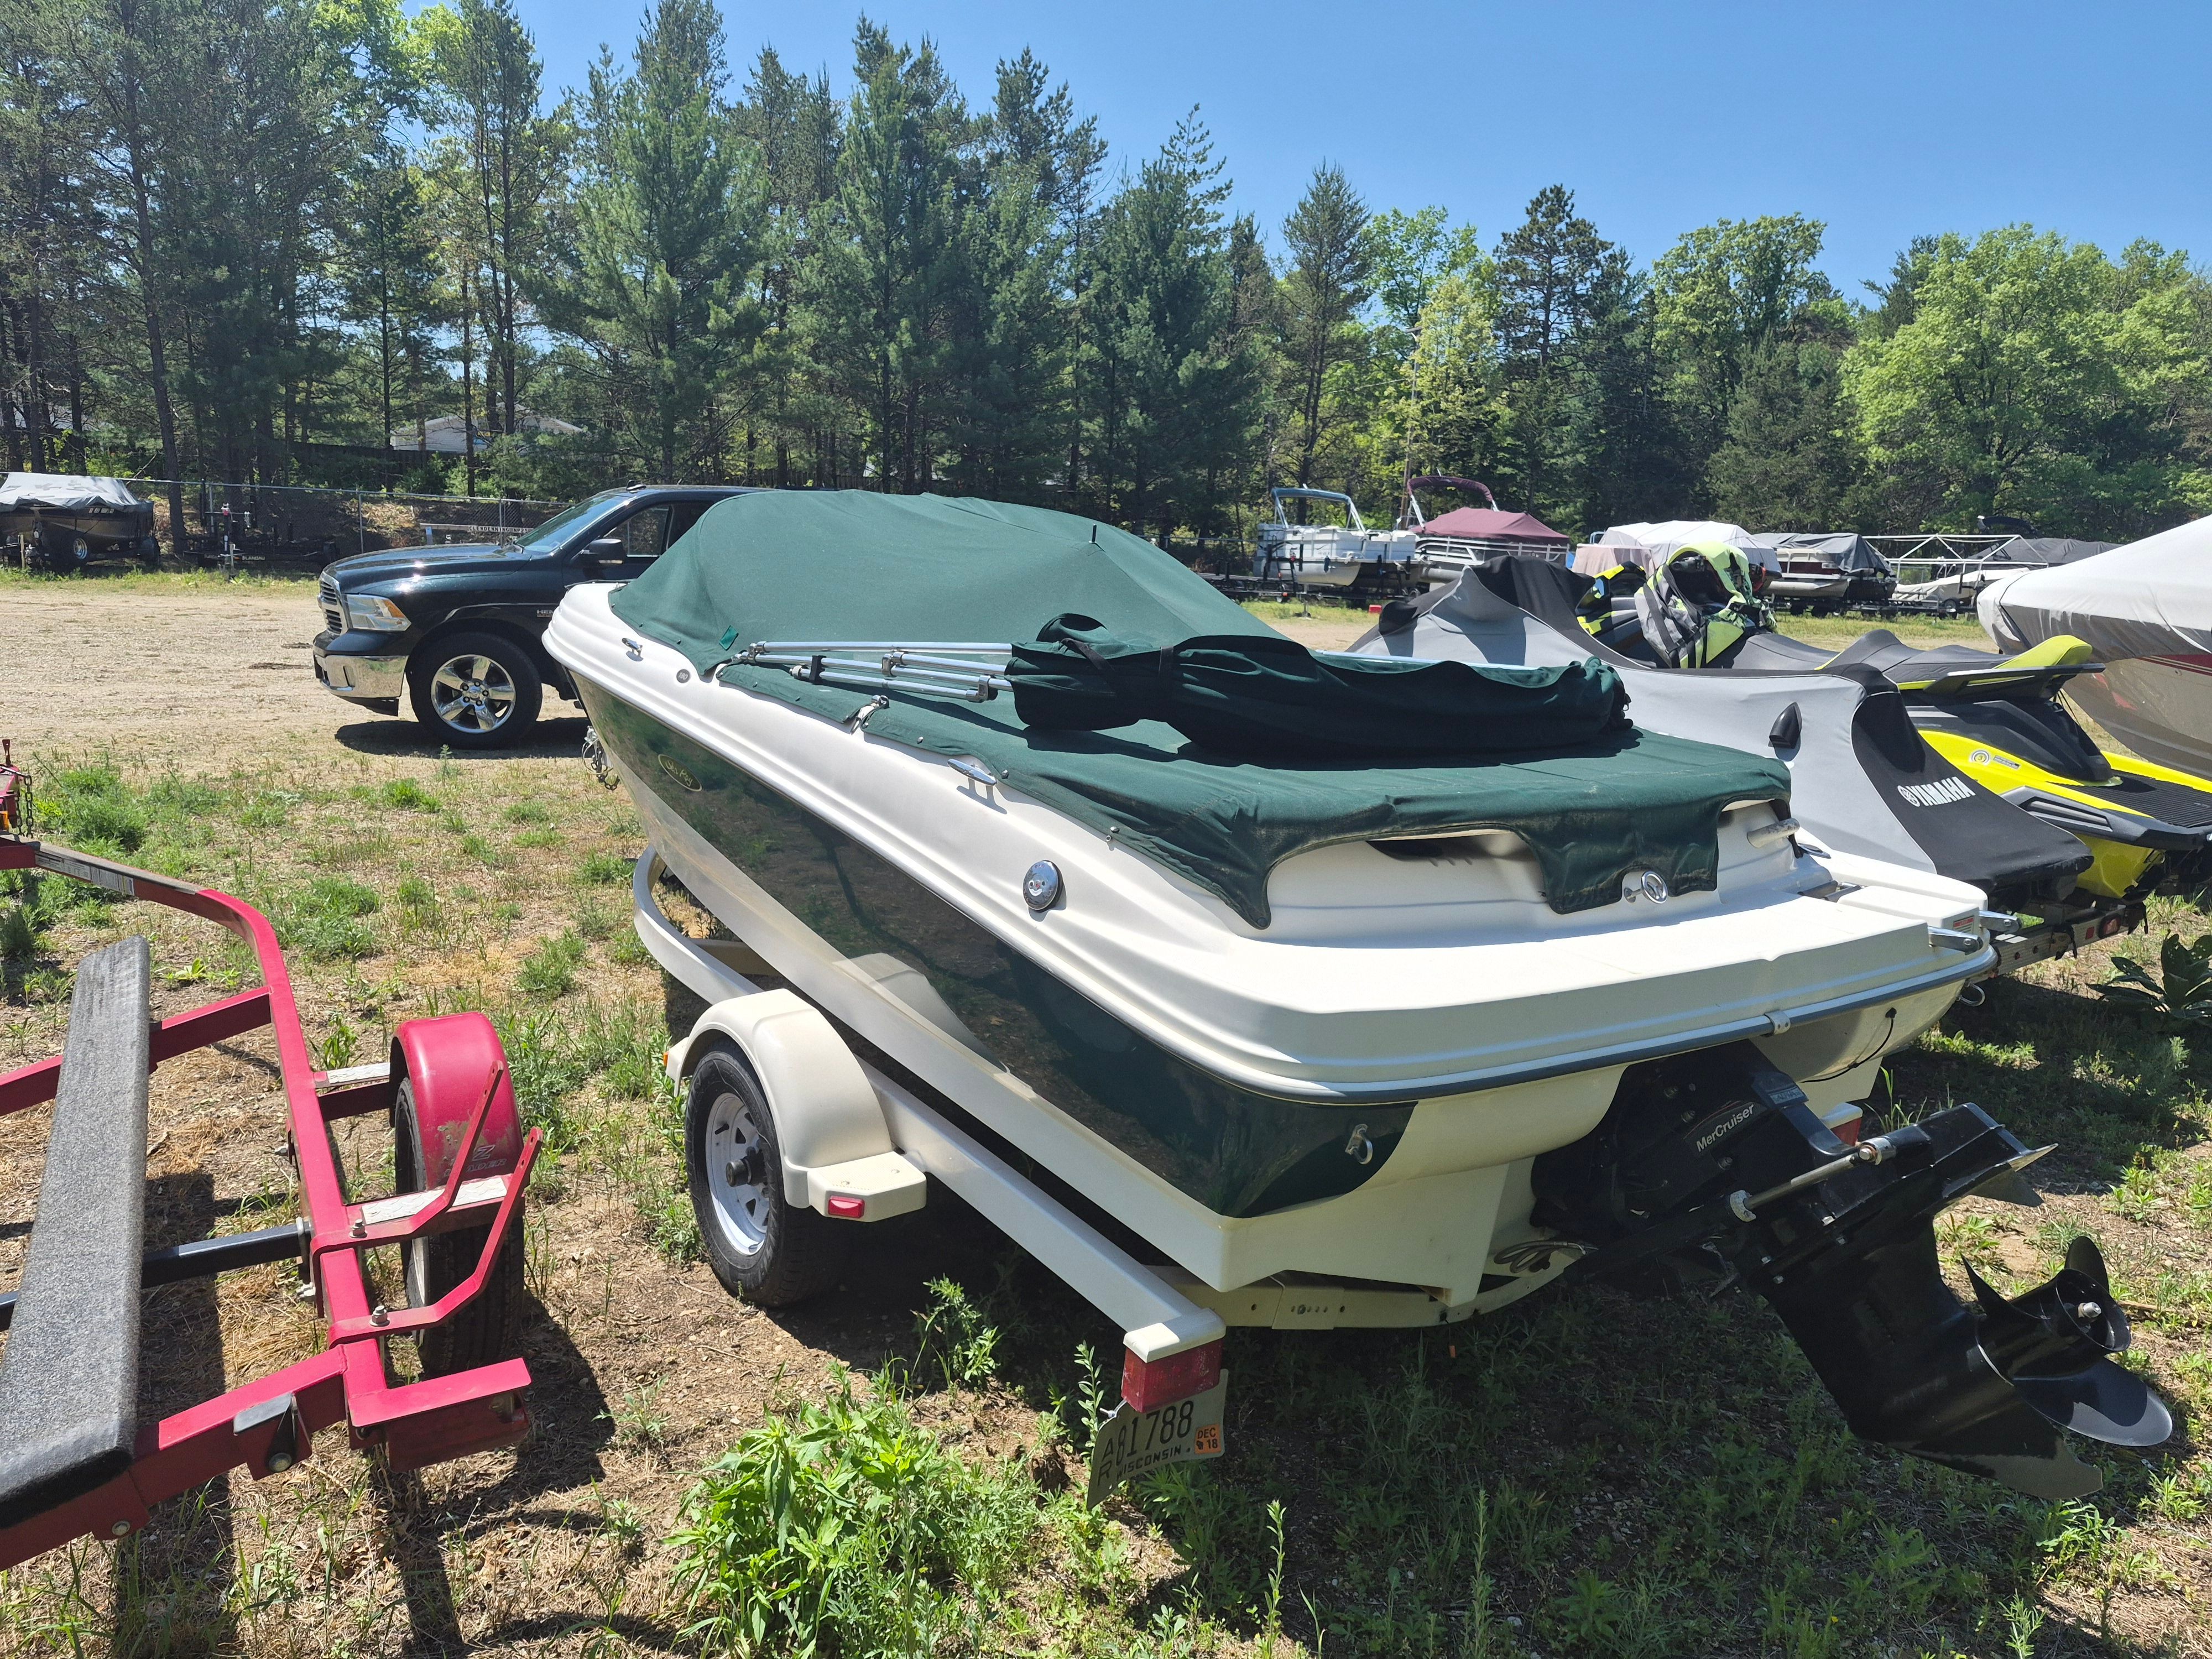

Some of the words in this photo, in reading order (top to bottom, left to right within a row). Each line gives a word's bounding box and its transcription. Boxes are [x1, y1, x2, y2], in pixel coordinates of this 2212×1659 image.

[1906, 776, 1976, 806] YAMAHA
[1696, 1104, 1754, 1152] MerCruiser
[1197, 1427, 1216, 1439] DEC
[1207, 1439, 1218, 1449] 18
[1117, 1444, 1181, 1482] WISCONSIN
